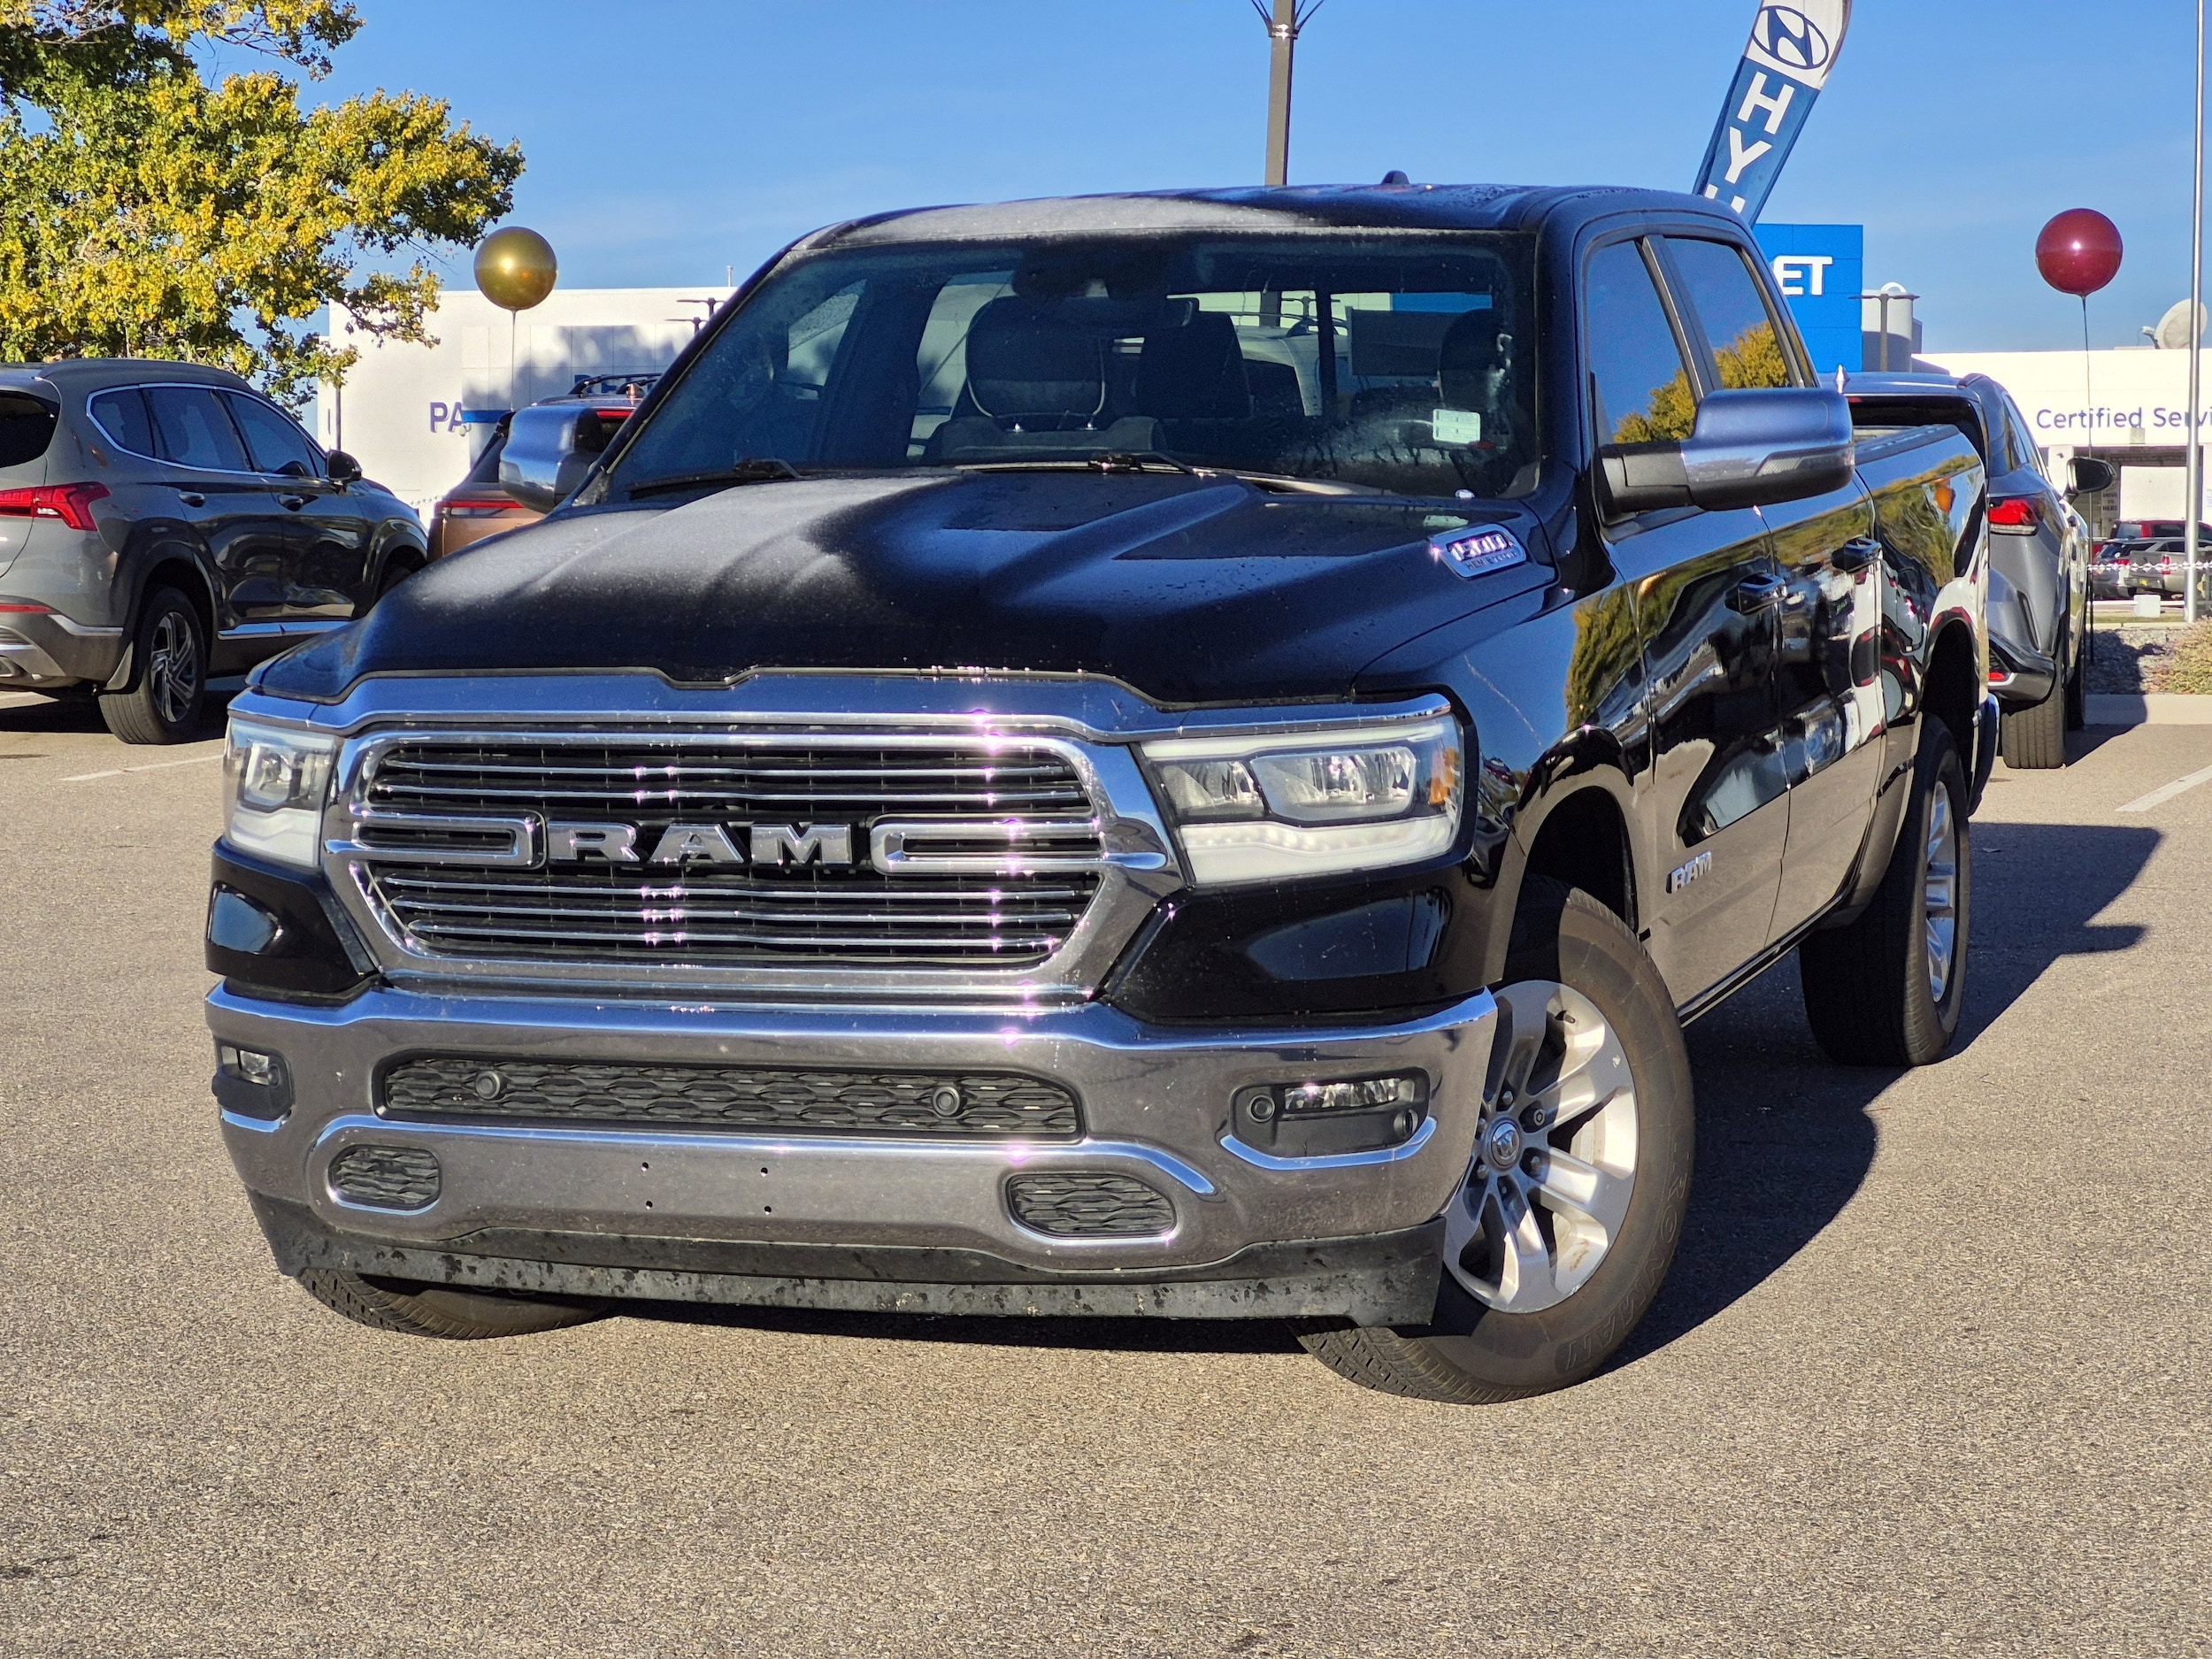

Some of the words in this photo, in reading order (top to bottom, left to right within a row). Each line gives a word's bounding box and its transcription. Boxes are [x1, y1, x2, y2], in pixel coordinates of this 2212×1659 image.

[1704, 71, 1795, 214] HY
[2036, 406, 2143, 429] Certified
[547, 819, 854, 865] RAM
[1666, 850, 1713, 894] RAM
